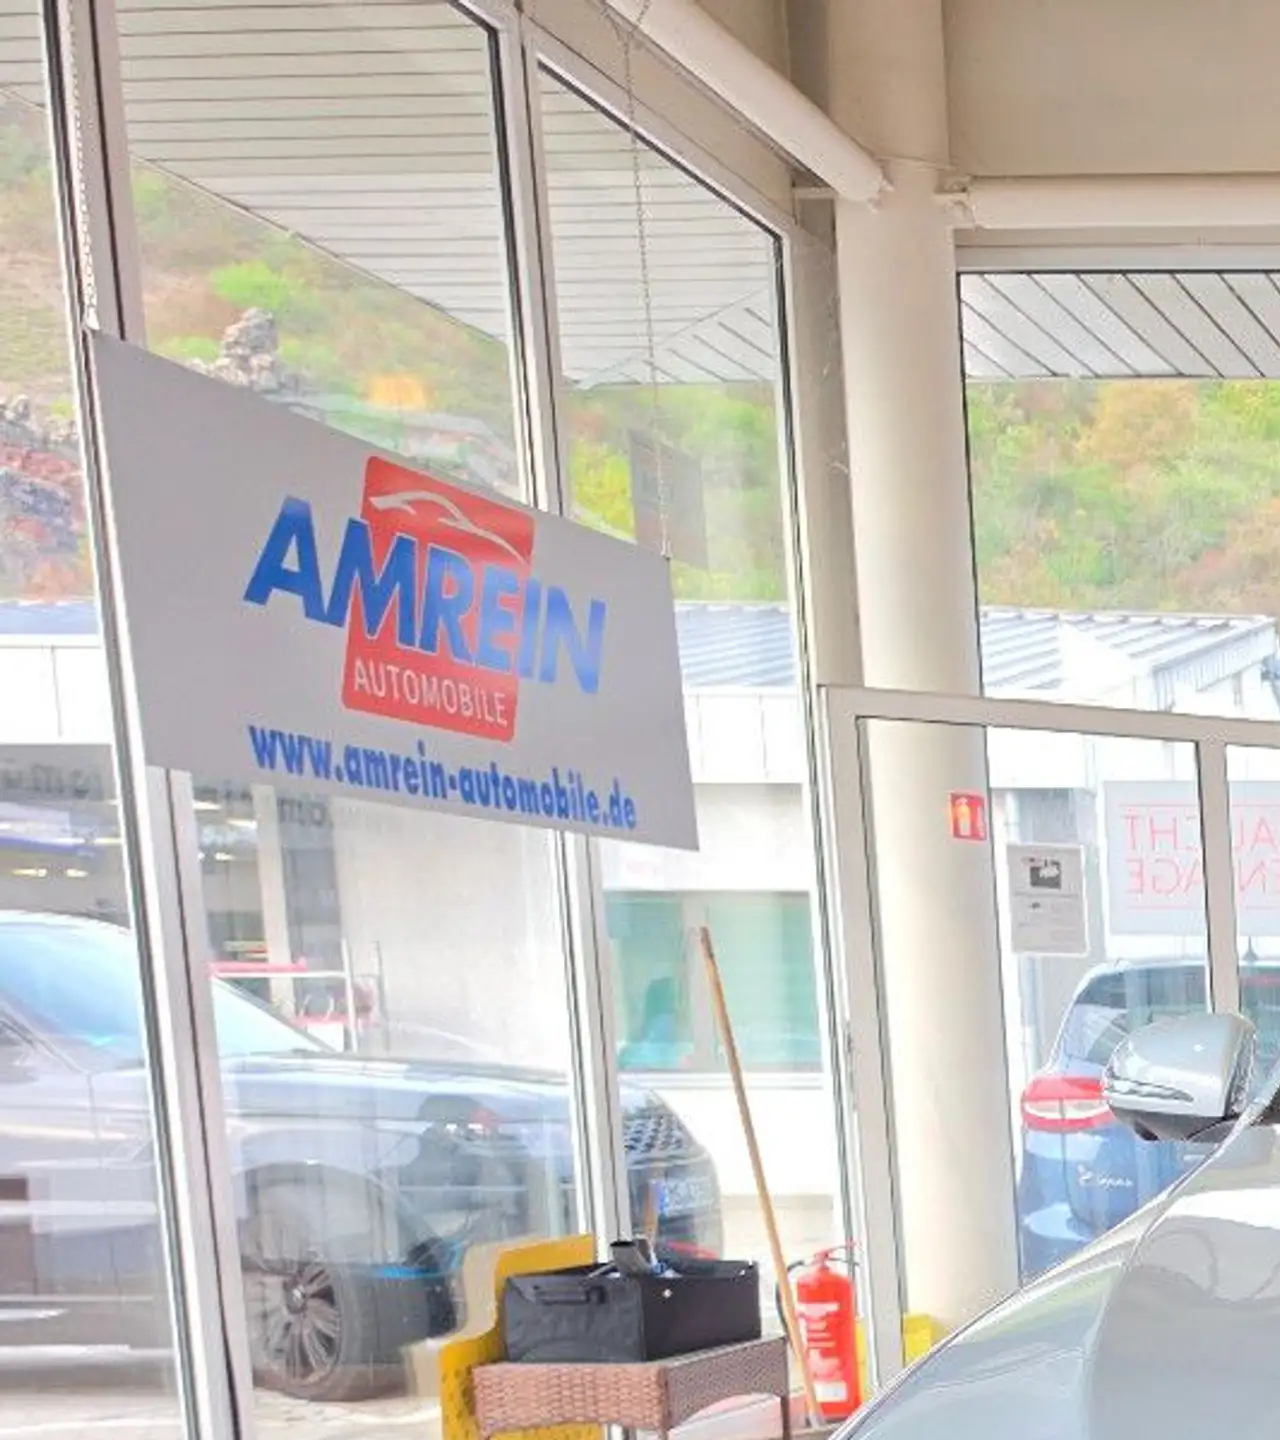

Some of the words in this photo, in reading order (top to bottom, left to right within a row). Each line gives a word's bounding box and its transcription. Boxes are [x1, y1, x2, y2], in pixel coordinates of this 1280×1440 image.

[242, 494, 607, 696] AMREIN
[353, 656, 509, 728] AUTOMOBILE
[248, 724, 637, 831] www.amrein-automobile.de
